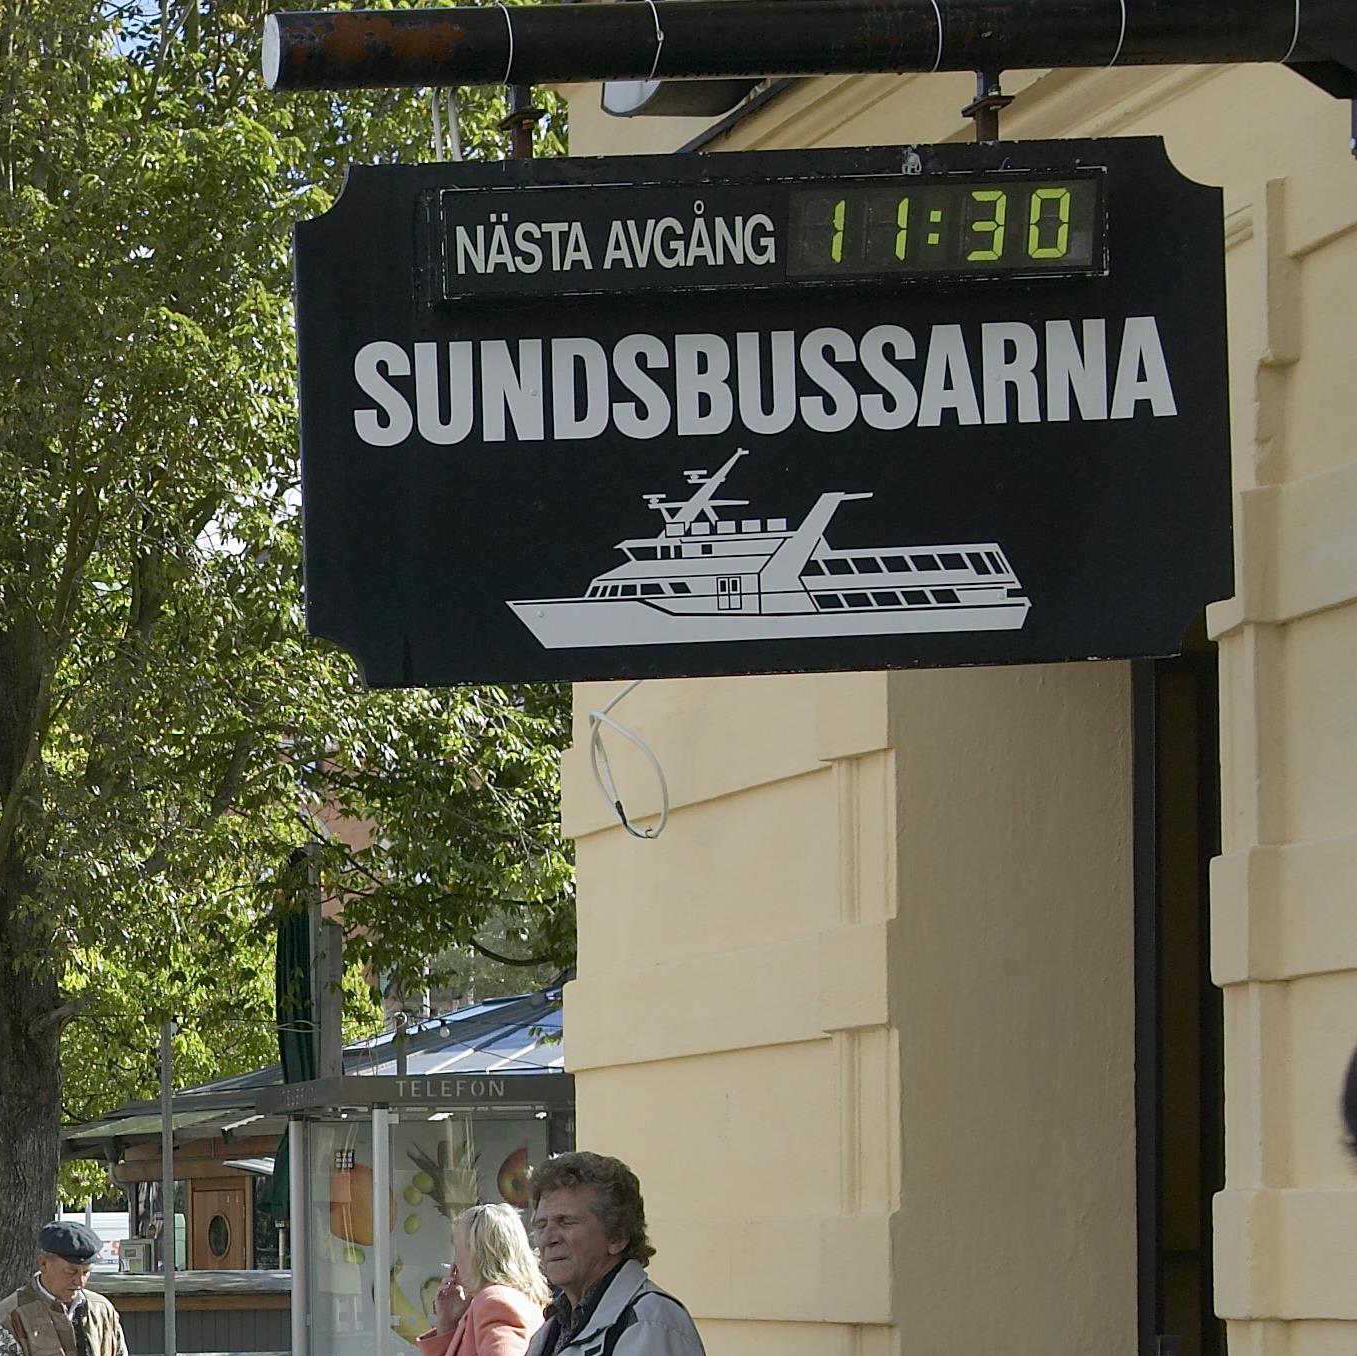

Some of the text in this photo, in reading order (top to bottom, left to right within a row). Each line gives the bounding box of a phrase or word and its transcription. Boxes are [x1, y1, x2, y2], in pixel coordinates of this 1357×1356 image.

[455, 200, 776, 275] NÄSTA AVGÅNG
[830, 188, 1071, 263] 11:30
[353, 316, 1178, 447] SUNDSBUSSARNA
[395, 1080, 505, 1097] TELEFON
